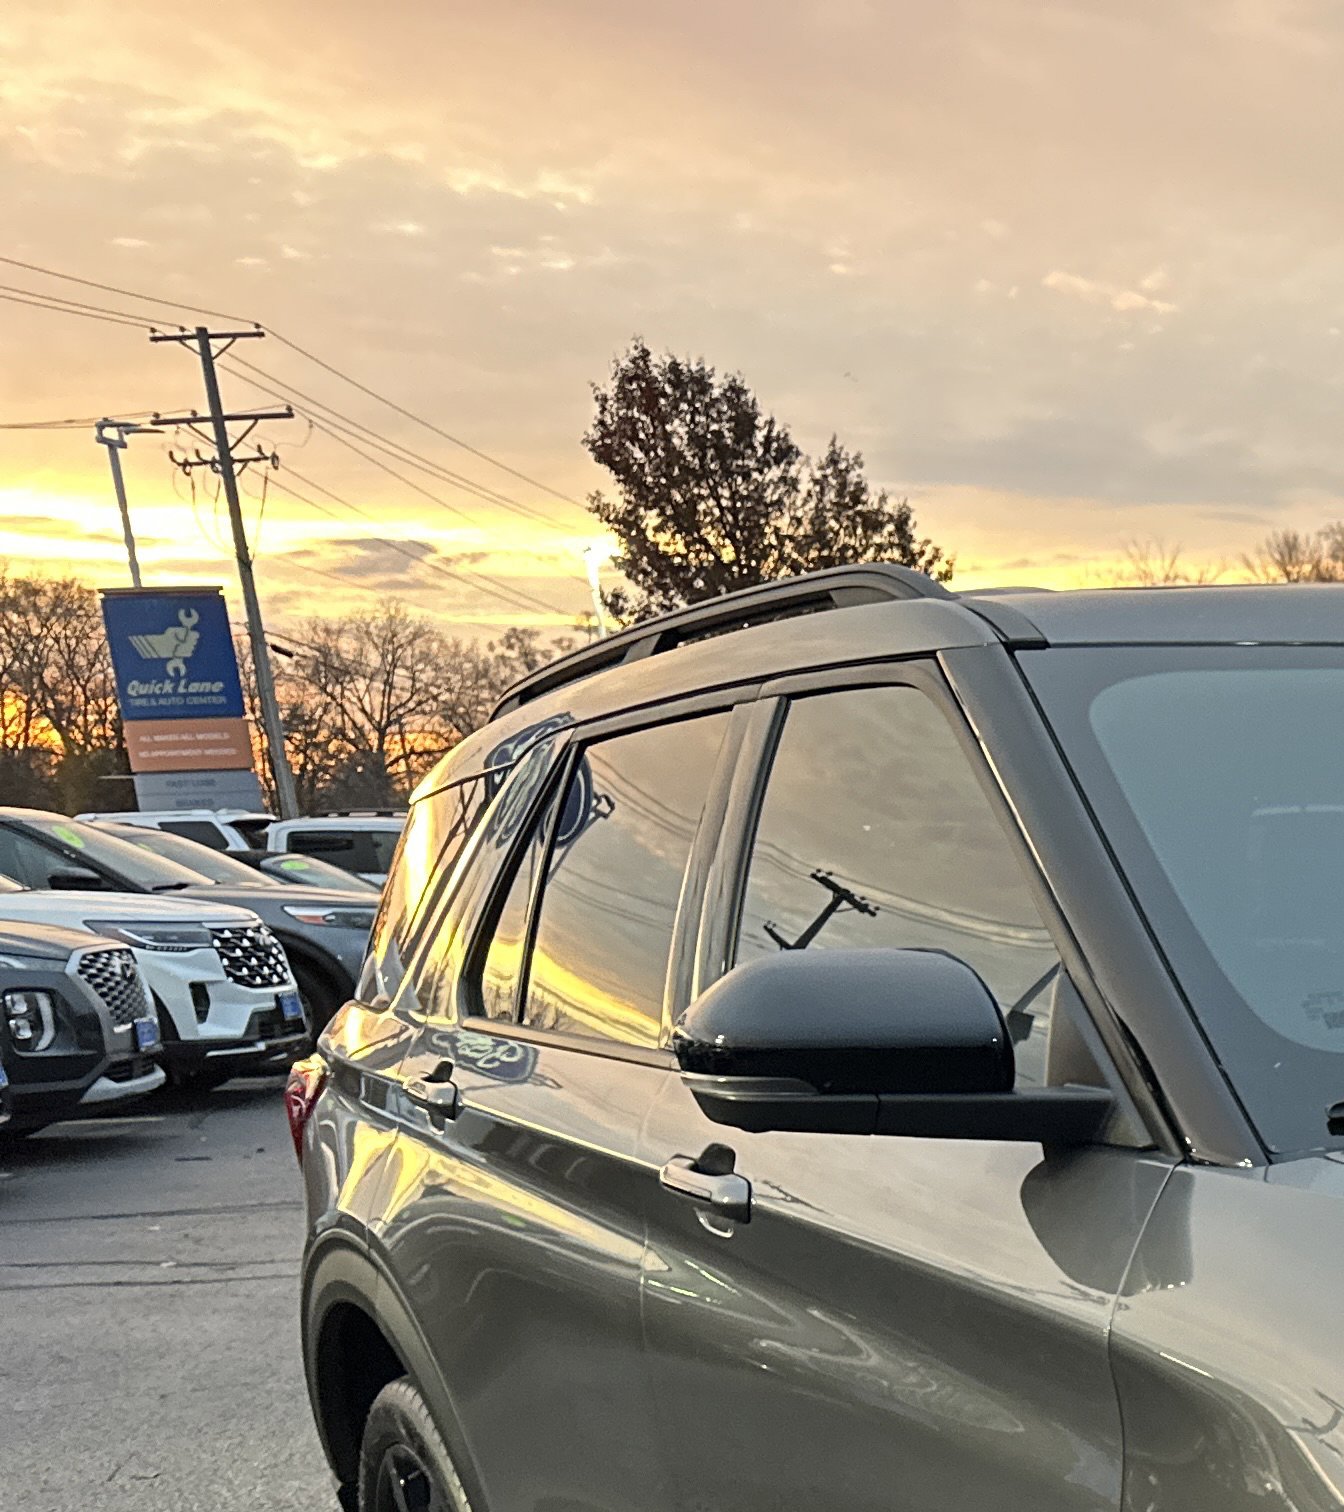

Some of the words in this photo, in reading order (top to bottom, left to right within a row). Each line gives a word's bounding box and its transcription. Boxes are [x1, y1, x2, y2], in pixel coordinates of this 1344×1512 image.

[127, 680, 173, 697] Quick
[177, 679, 225, 694] Lane
[157, 697, 185, 706] AUTO
[186, 695, 227, 705] CENTER
